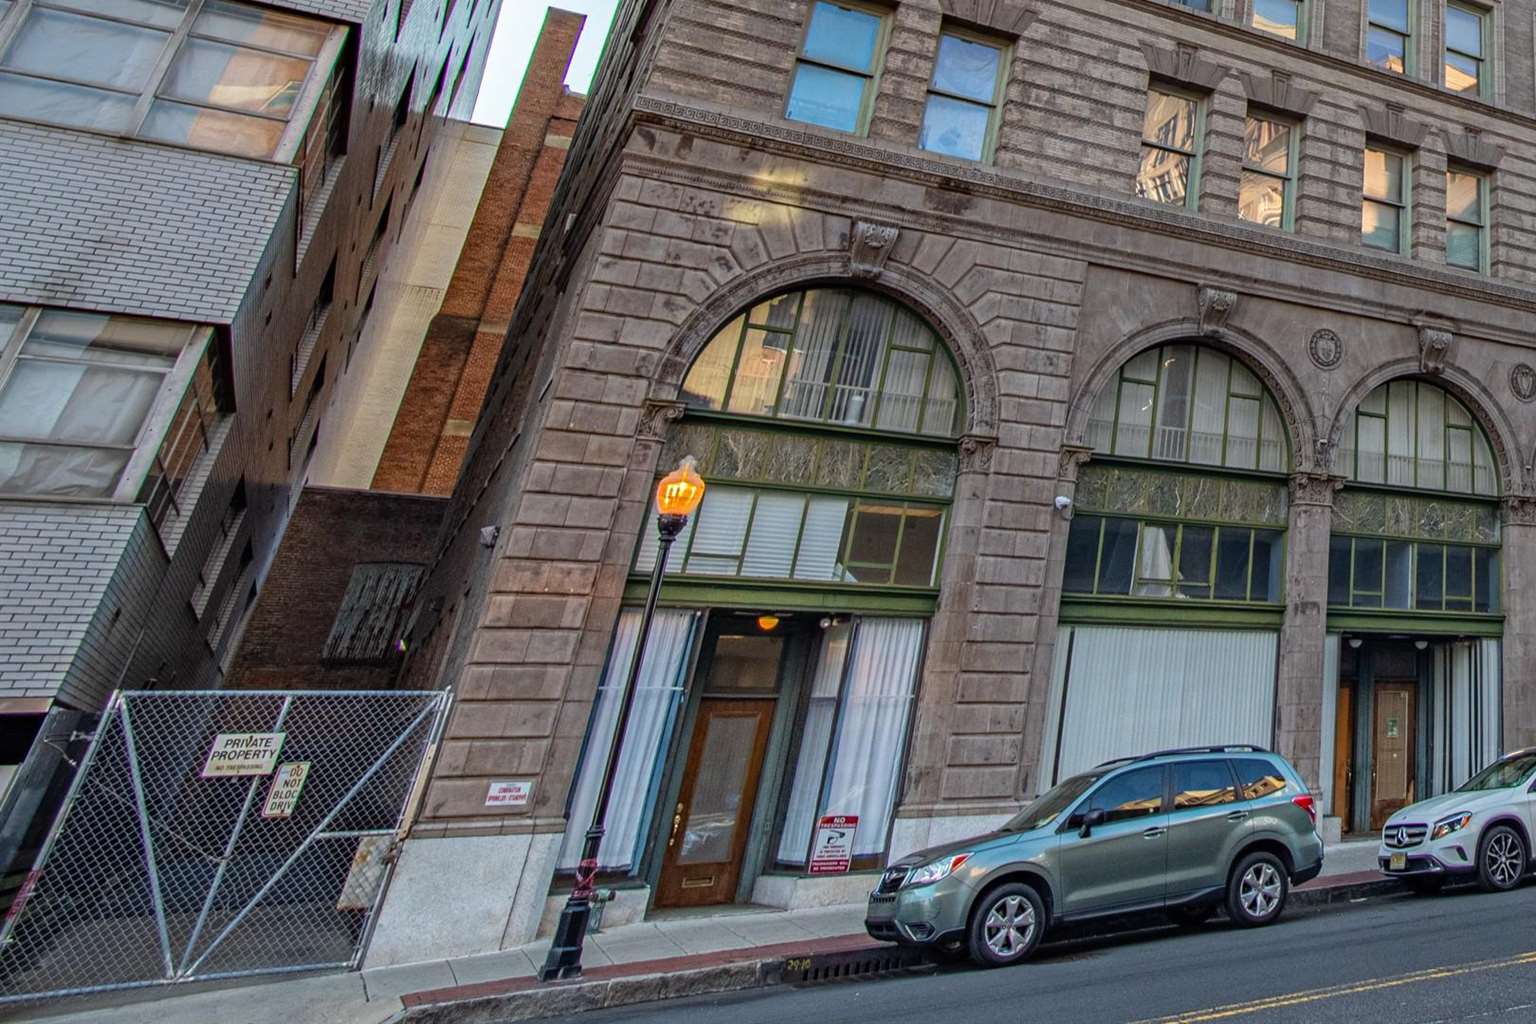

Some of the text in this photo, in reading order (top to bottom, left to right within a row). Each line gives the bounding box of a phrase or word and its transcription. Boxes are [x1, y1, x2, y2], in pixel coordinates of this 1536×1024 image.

[224, 737, 273, 748] PRIVATE
[211, 749, 276, 760] PROPERTY
[290, 767, 303, 777] DO
[283, 778, 302, 788] NOT
